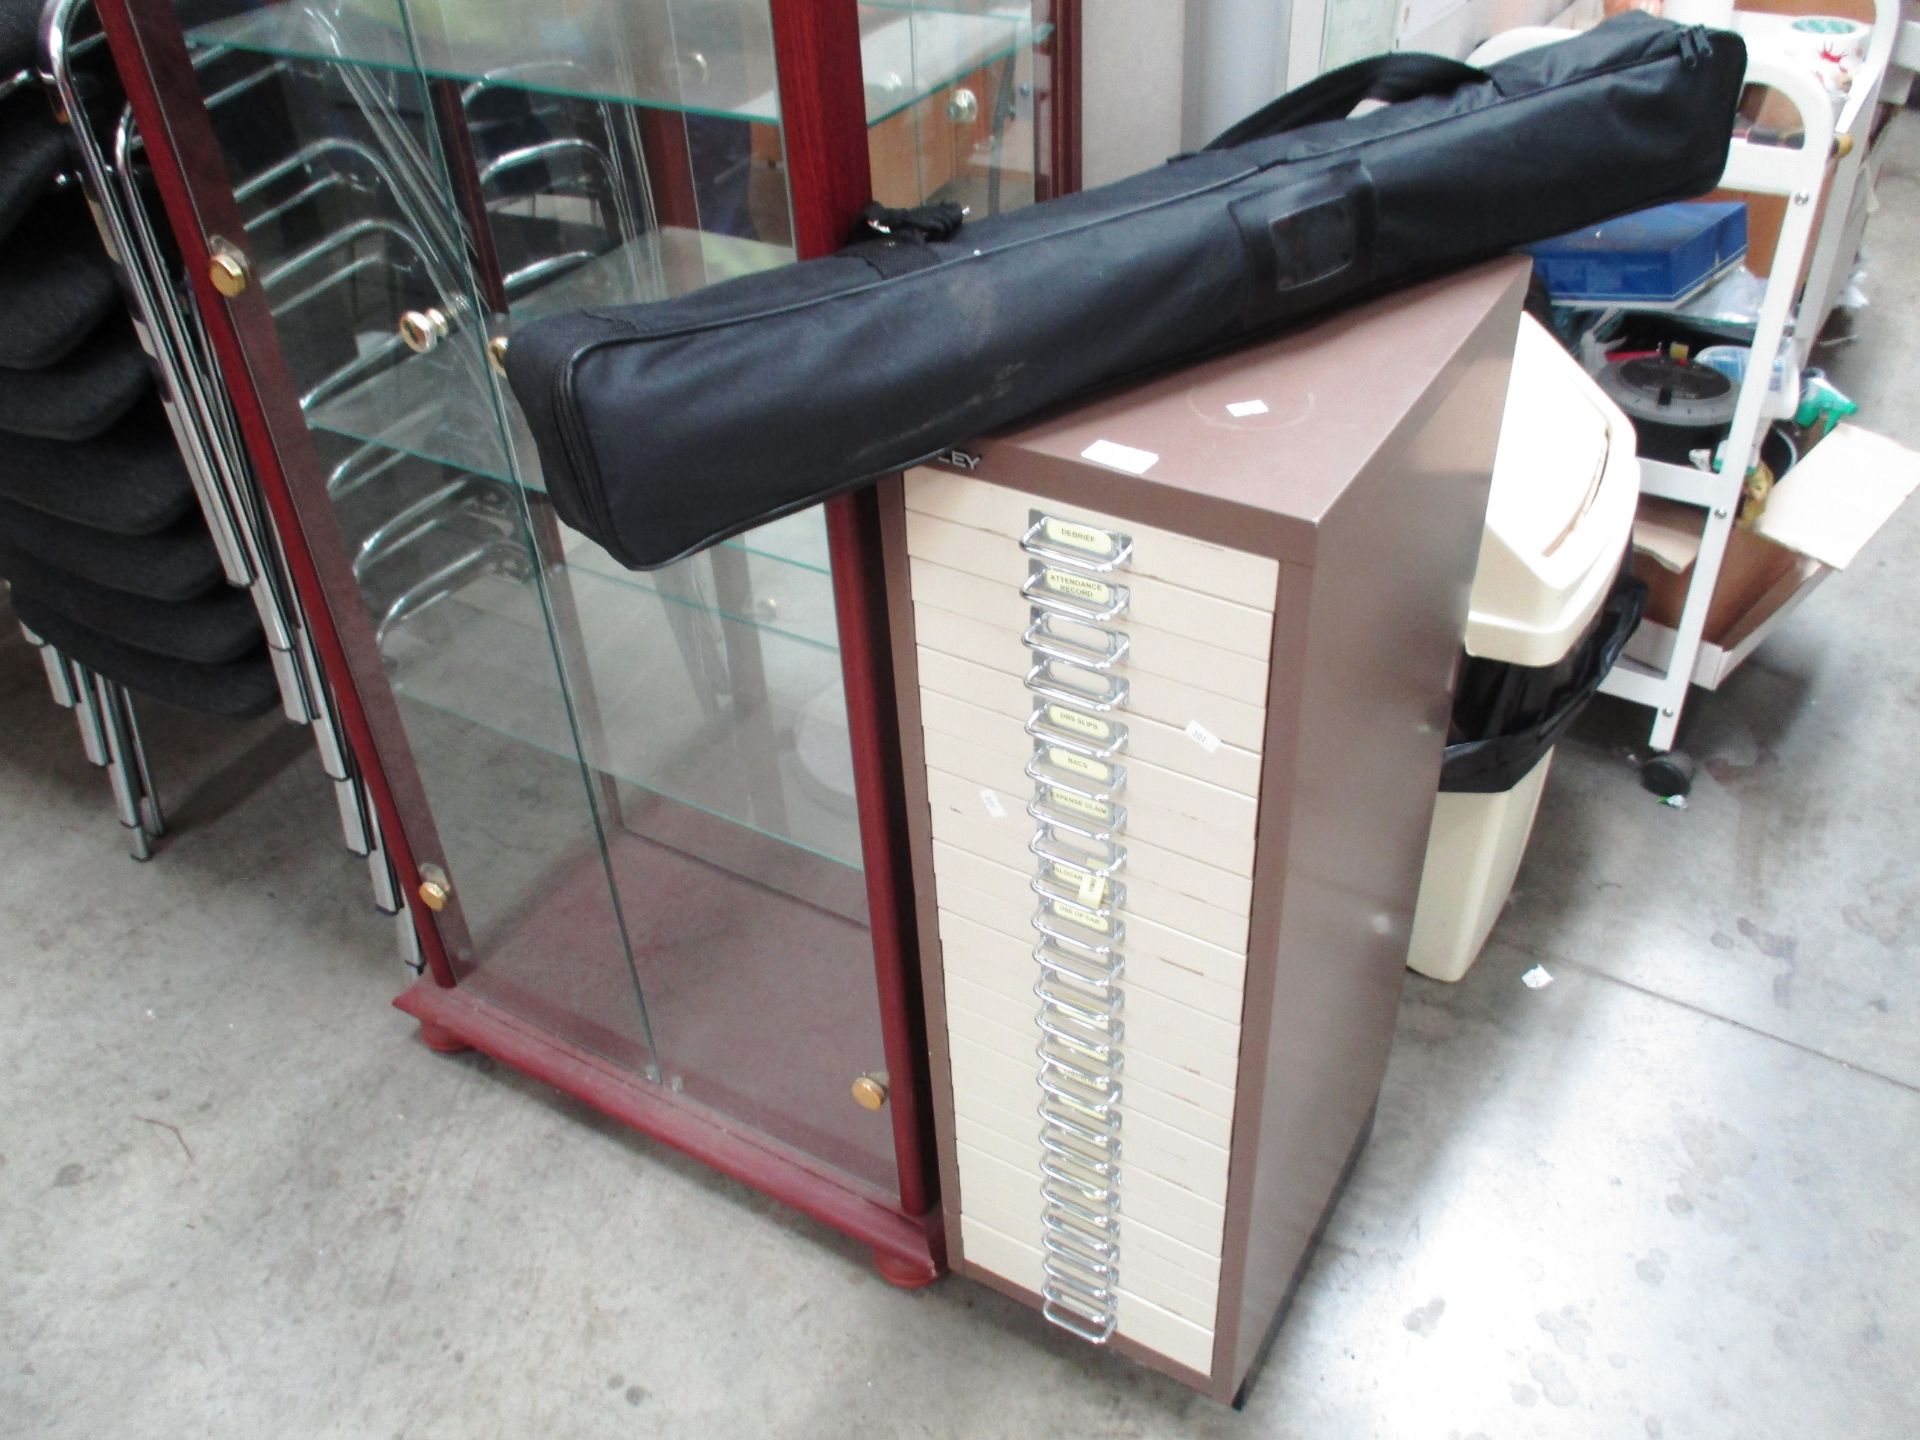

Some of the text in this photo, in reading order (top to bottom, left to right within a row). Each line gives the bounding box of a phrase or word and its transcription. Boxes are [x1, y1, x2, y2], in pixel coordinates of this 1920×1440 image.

[1061, 528, 1095, 542] DEBRIEF
[1050, 574, 1103, 591] ATTENDANCE
[1060, 585, 1093, 598] RECORD
[1085, 802, 1107, 815] CLAIM
